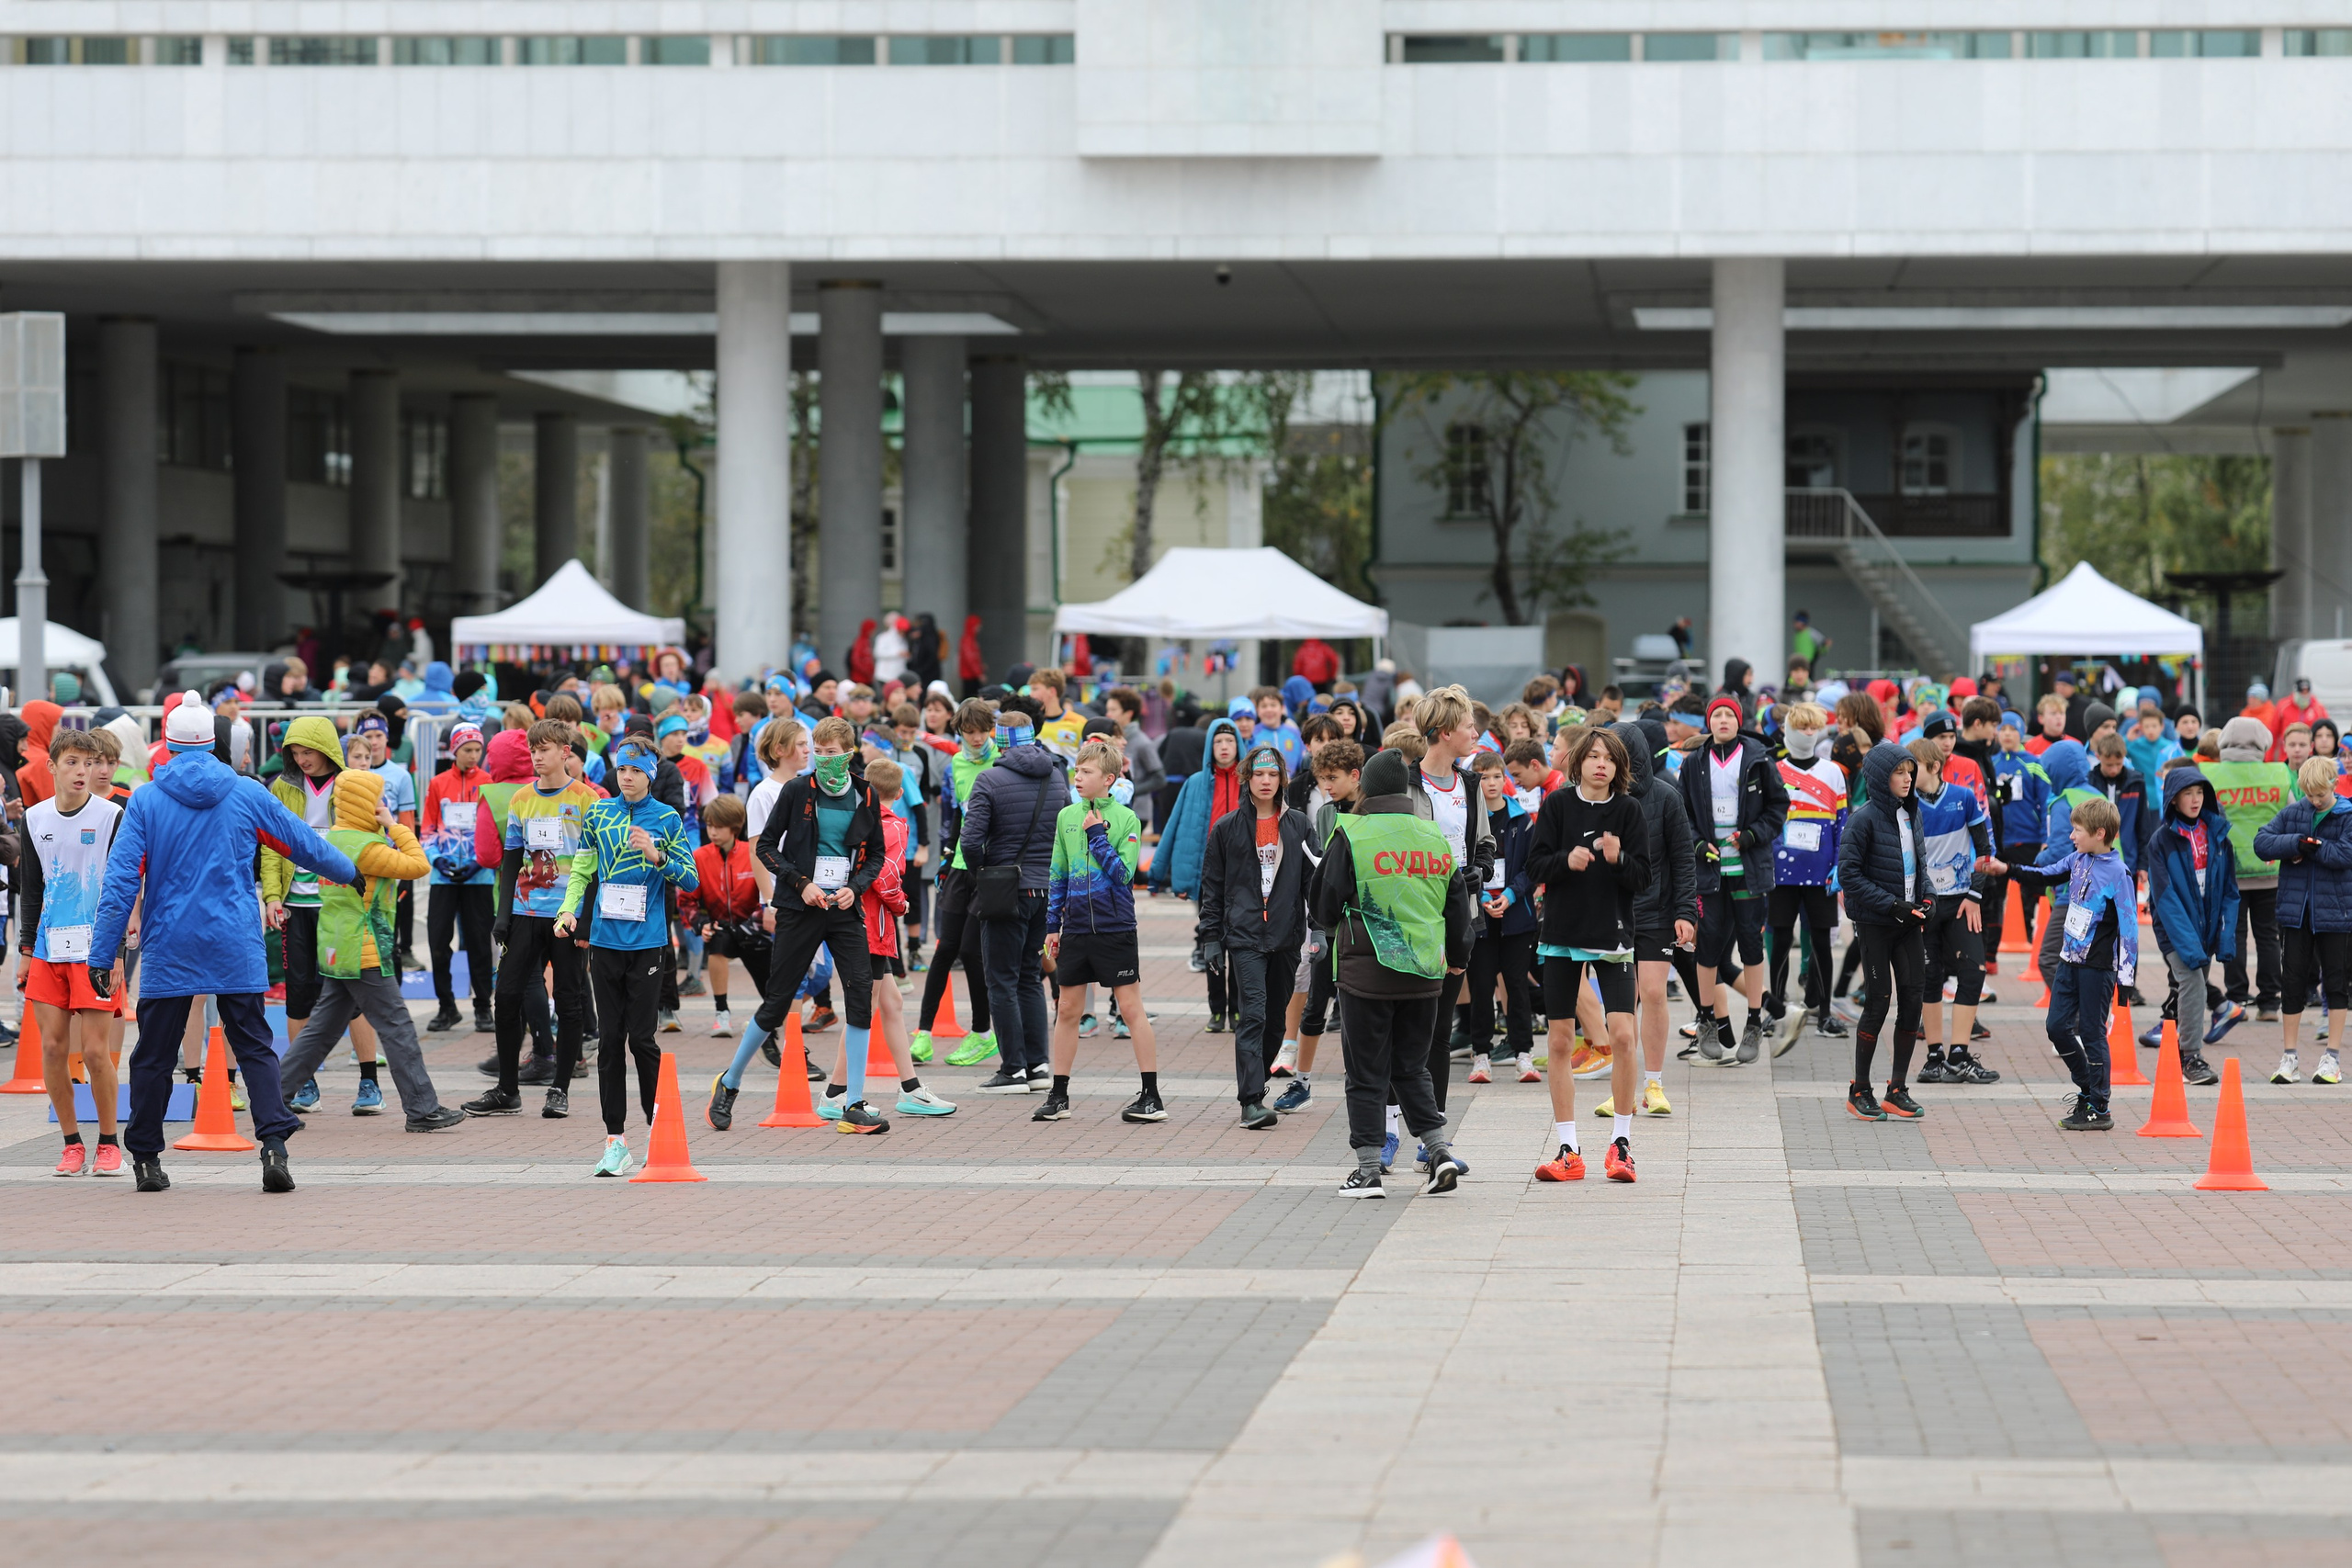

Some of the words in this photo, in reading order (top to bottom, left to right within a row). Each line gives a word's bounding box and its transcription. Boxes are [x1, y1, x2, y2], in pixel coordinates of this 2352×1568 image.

[2216, 786, 2280, 807] СУДЬЯ
[1717, 806, 1726, 814] 62
[537, 829, 547, 838] 34
[1374, 851, 1452, 879] СУДЬЯ
[823, 868, 834, 878] 23
[619, 897, 625, 906] 7
[65, 940, 71, 949] 2
[1116, 968, 1135, 978] FILA
